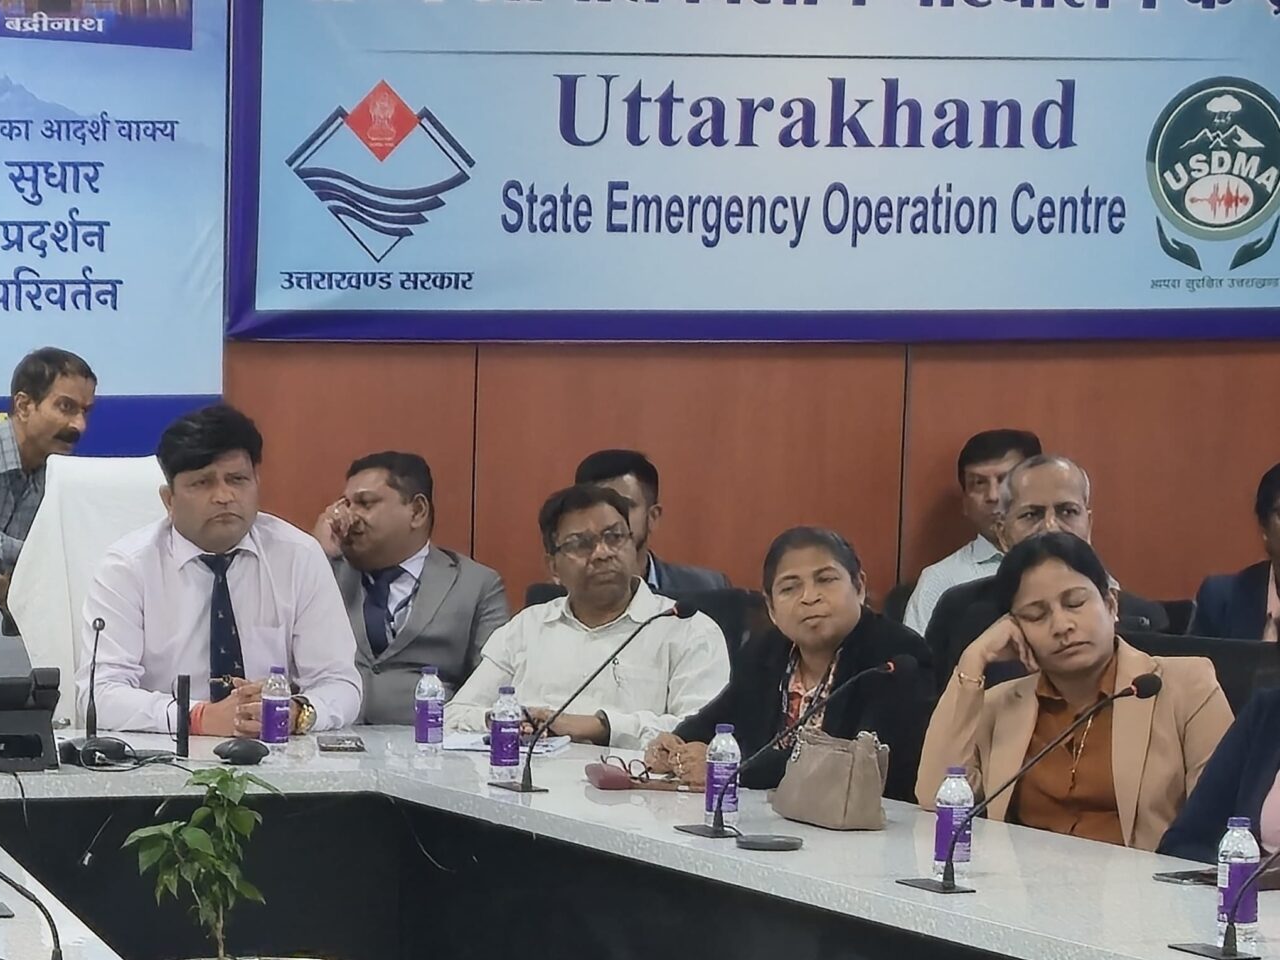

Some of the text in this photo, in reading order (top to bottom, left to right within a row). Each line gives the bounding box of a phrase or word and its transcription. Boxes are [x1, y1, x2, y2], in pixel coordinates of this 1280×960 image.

[4, 11, 105, 33] बद्रीनाथ
[0, 117, 33, 143] का
[40, 111, 111, 145] आदर्श
[116, 118, 178, 143] वाक्य
[553, 72, 1078, 152] Uttarakhand
[5, 160, 104, 205] सुधार
[1163, 149, 1280, 194] USDMA
[500, 180, 1128, 250] State Emergency Operation Centre
[279, 271, 475, 292] उत्तराखण्ड सरकार
